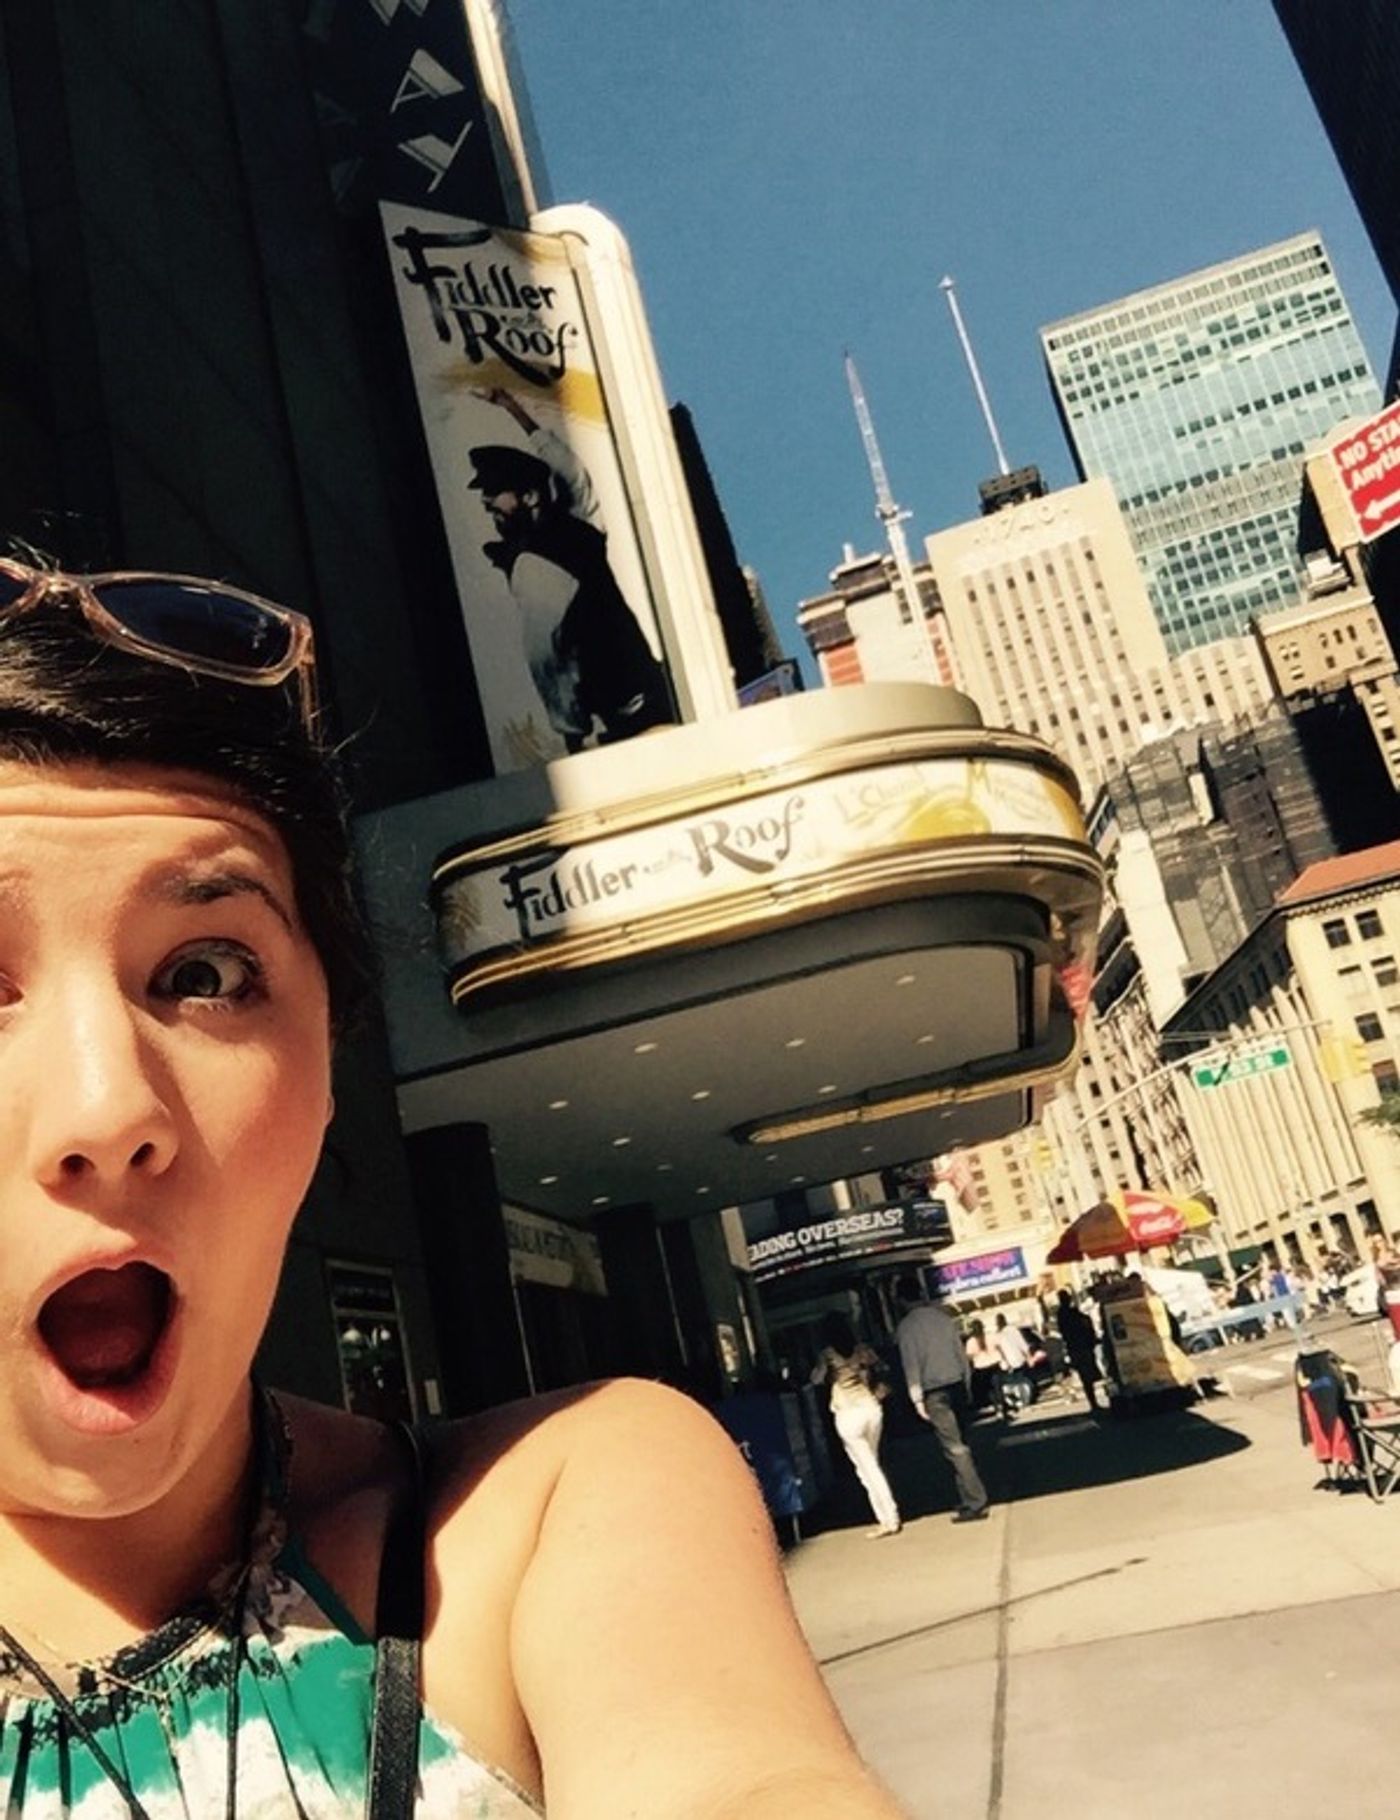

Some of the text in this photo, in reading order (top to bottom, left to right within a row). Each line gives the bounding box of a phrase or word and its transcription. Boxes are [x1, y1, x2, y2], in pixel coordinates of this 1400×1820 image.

[392, 226, 556, 343] Fiddler
[451, 306, 578, 388] Roof
[1340, 412, 1400, 469] NO STA
[499, 795, 805, 941] Fiddler Roof
[798, 1208, 904, 1245] OVERSEAS?
